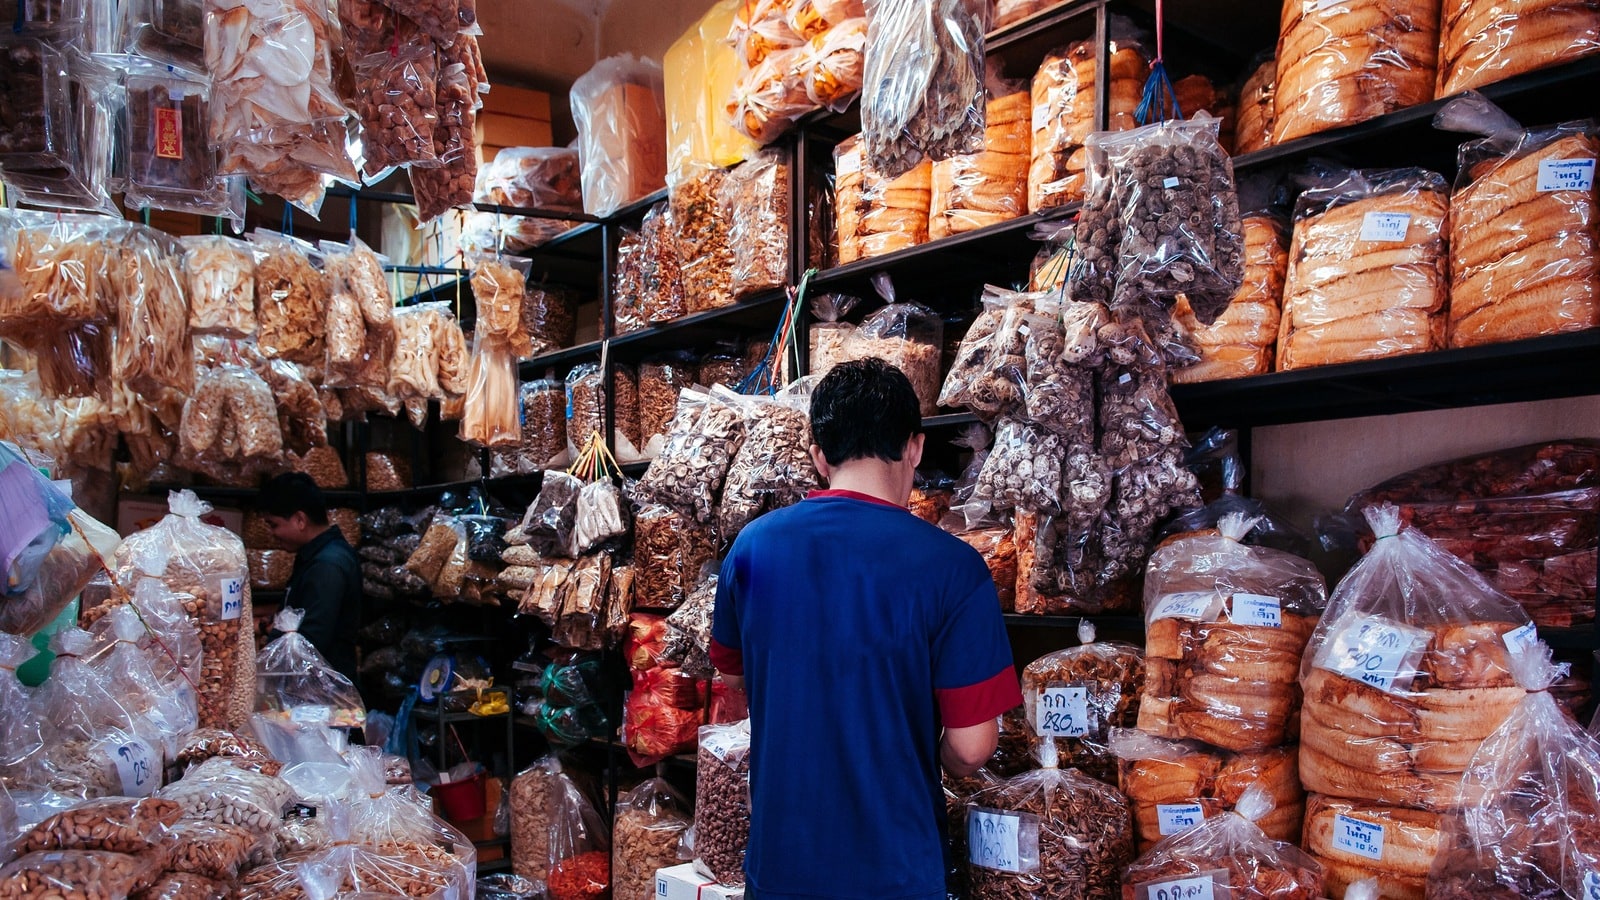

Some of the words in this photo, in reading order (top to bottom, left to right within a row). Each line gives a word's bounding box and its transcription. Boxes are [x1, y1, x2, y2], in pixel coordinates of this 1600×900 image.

[1042, 710, 1073, 732] 280
[1345, 825, 1372, 843] ใหญ่
[1355, 841, 1366, 850] 10
